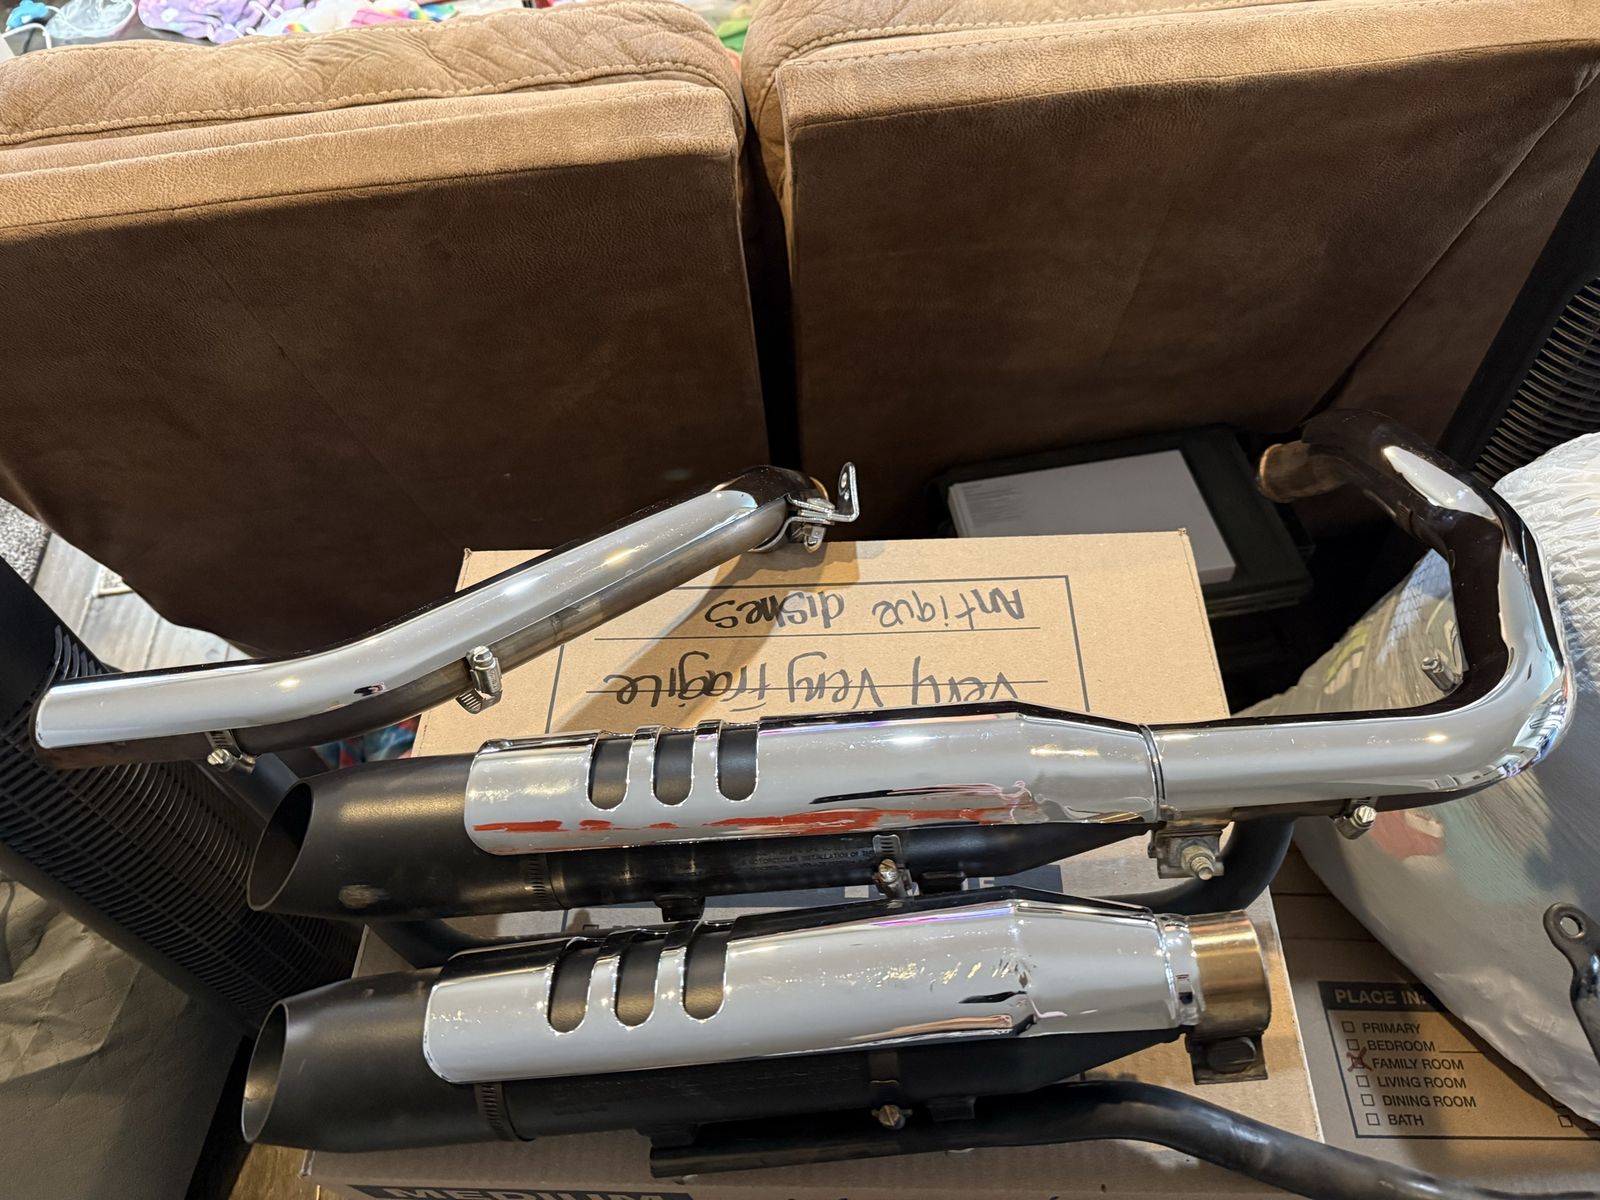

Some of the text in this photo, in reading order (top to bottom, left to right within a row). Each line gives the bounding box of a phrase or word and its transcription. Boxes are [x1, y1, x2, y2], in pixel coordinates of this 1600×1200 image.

[705, 587, 1025, 630] Antique dishes
[788, 651, 884, 709] Very
[912, 655, 1019, 705] Very
[1334, 989, 1396, 1004] PLACE
[1362, 1022, 1421, 1034] PRIMARY
[1367, 1040, 1436, 1051] BEDROOM
[1372, 1058, 1464, 1070] FAMILY ROOM
[1377, 1077, 1467, 1088] LIVING ROOM
[1383, 1095, 1477, 1108] DINING ROOM
[1388, 1114, 1424, 1126] BATH
